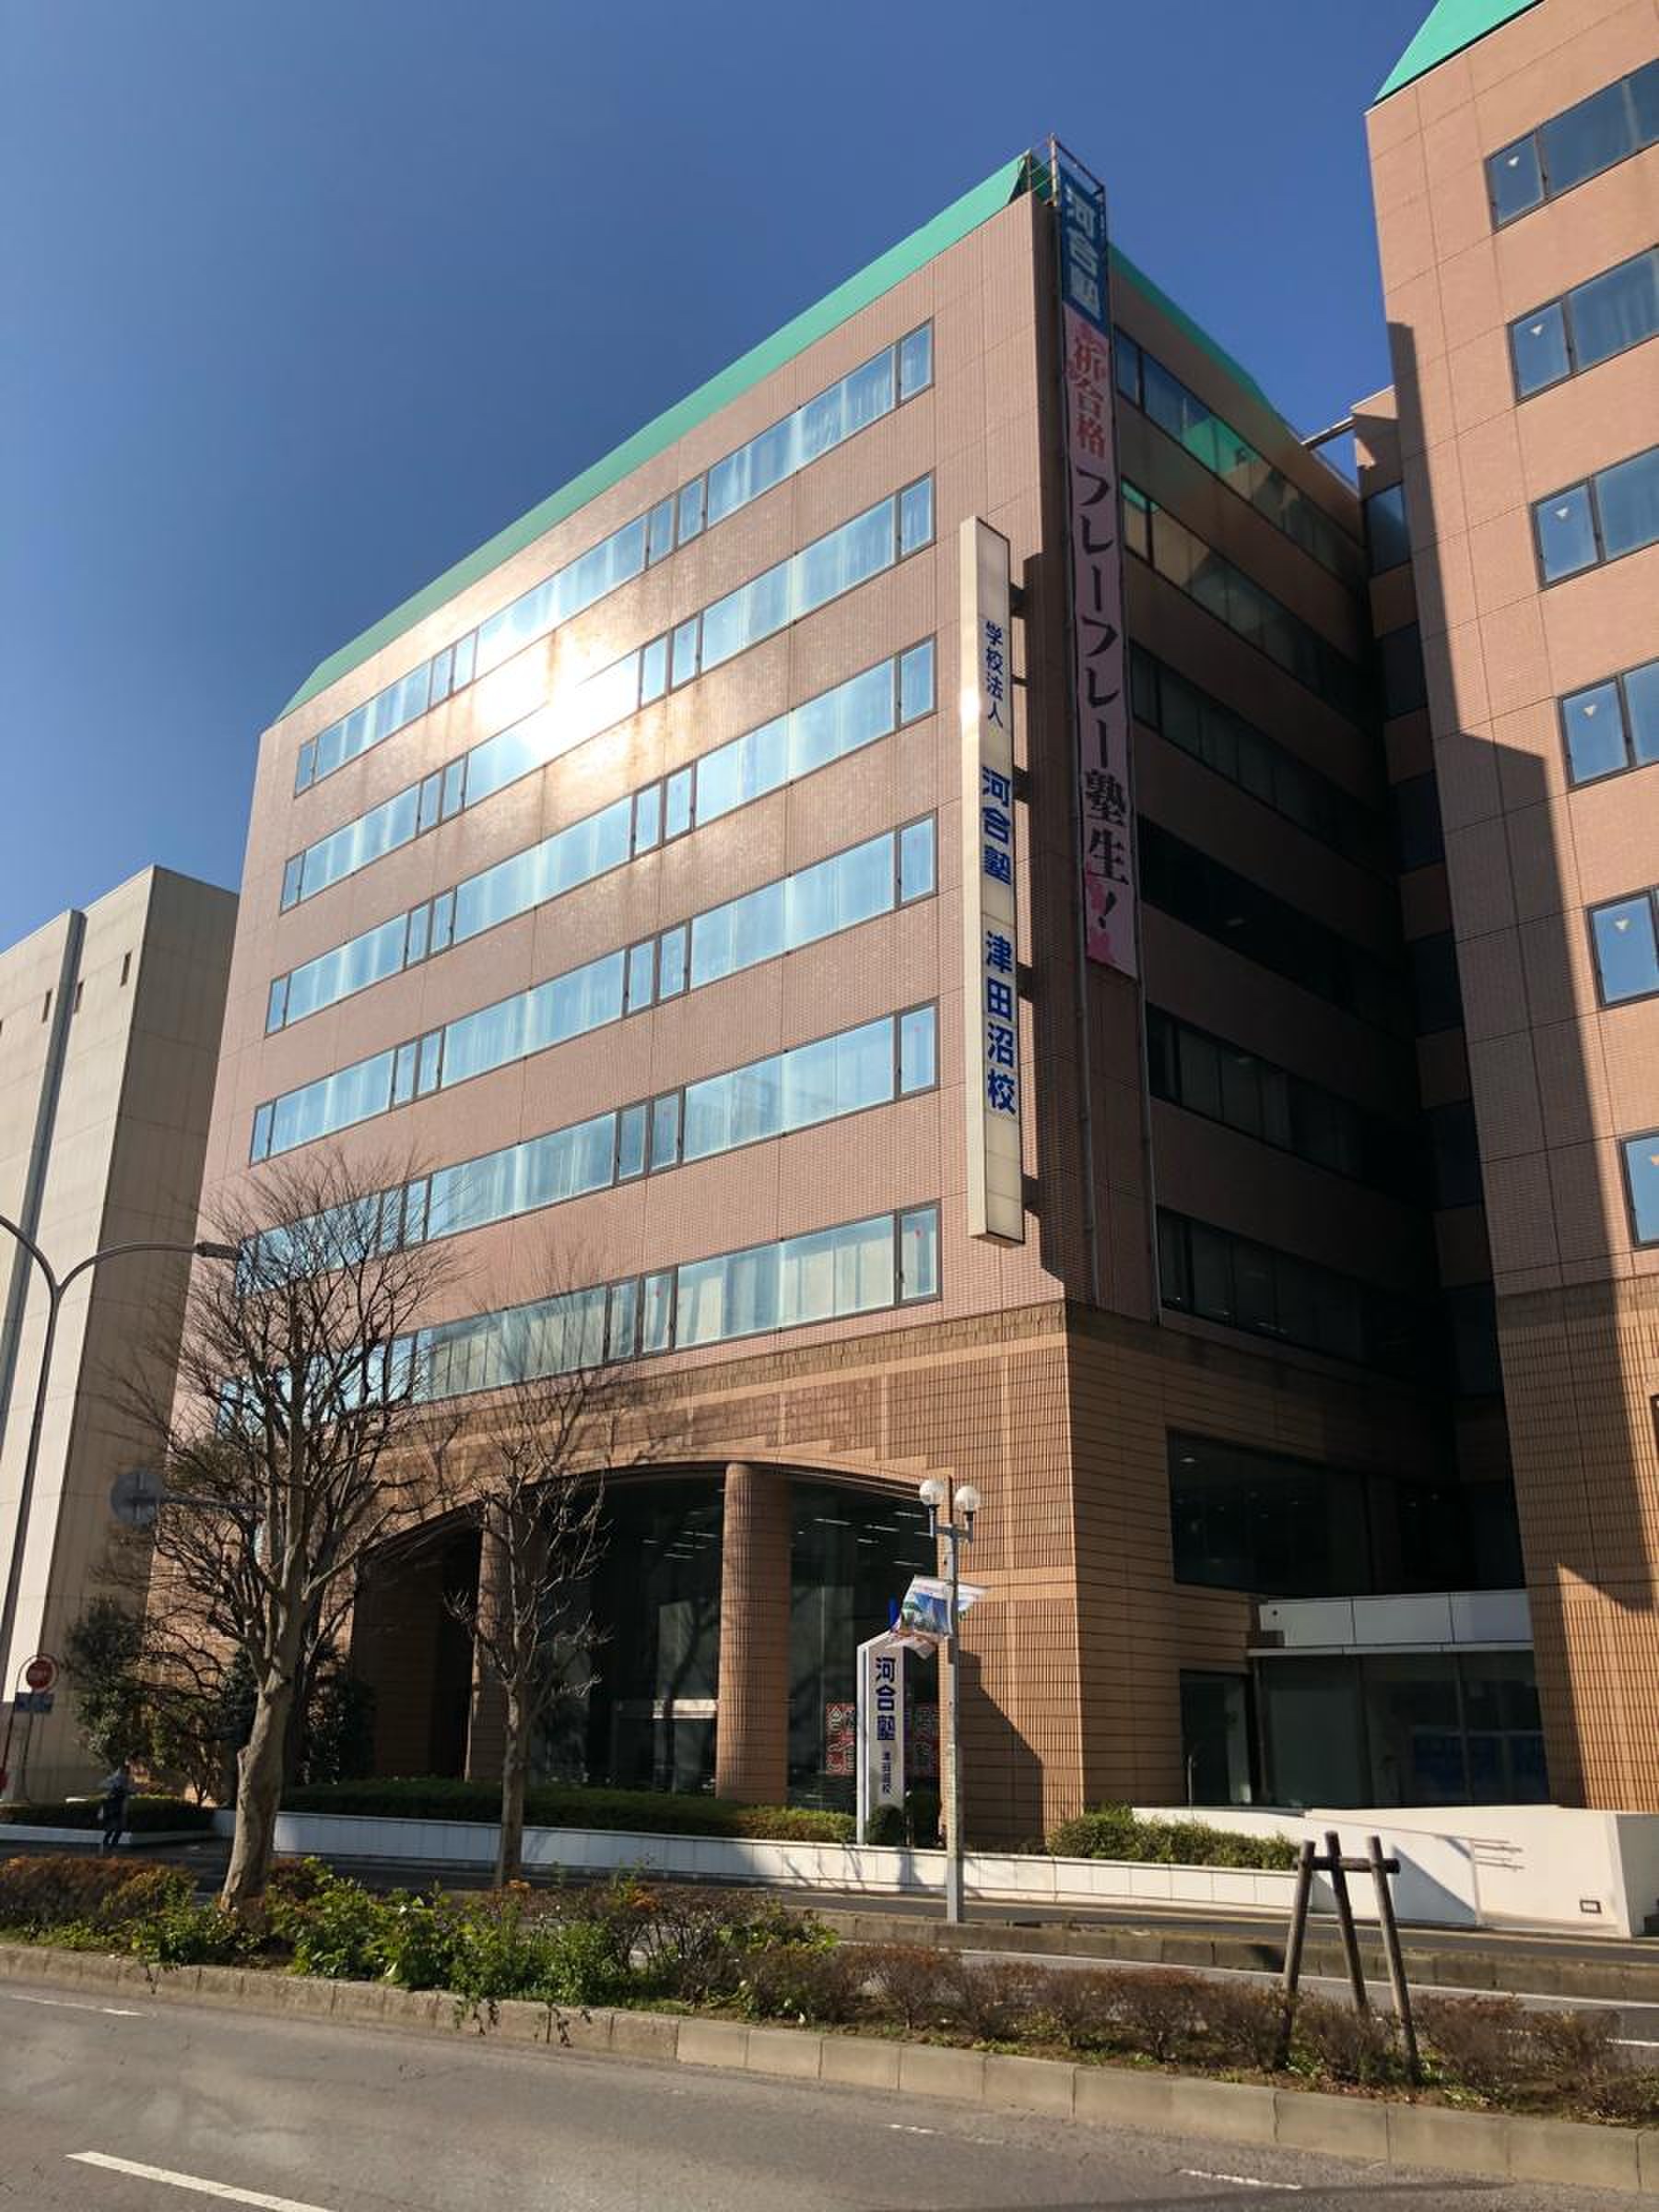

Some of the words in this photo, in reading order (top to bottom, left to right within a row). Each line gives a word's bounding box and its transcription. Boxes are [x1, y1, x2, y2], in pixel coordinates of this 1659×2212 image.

[1065, 182, 1101, 321] 河合塾
[985, 620, 1004, 729] 学校法人
[982, 766, 1011, 886] 河合塾
[986, 930, 1017, 1115] 津田沼校
[876, 1656, 896, 1741] 河合塾
